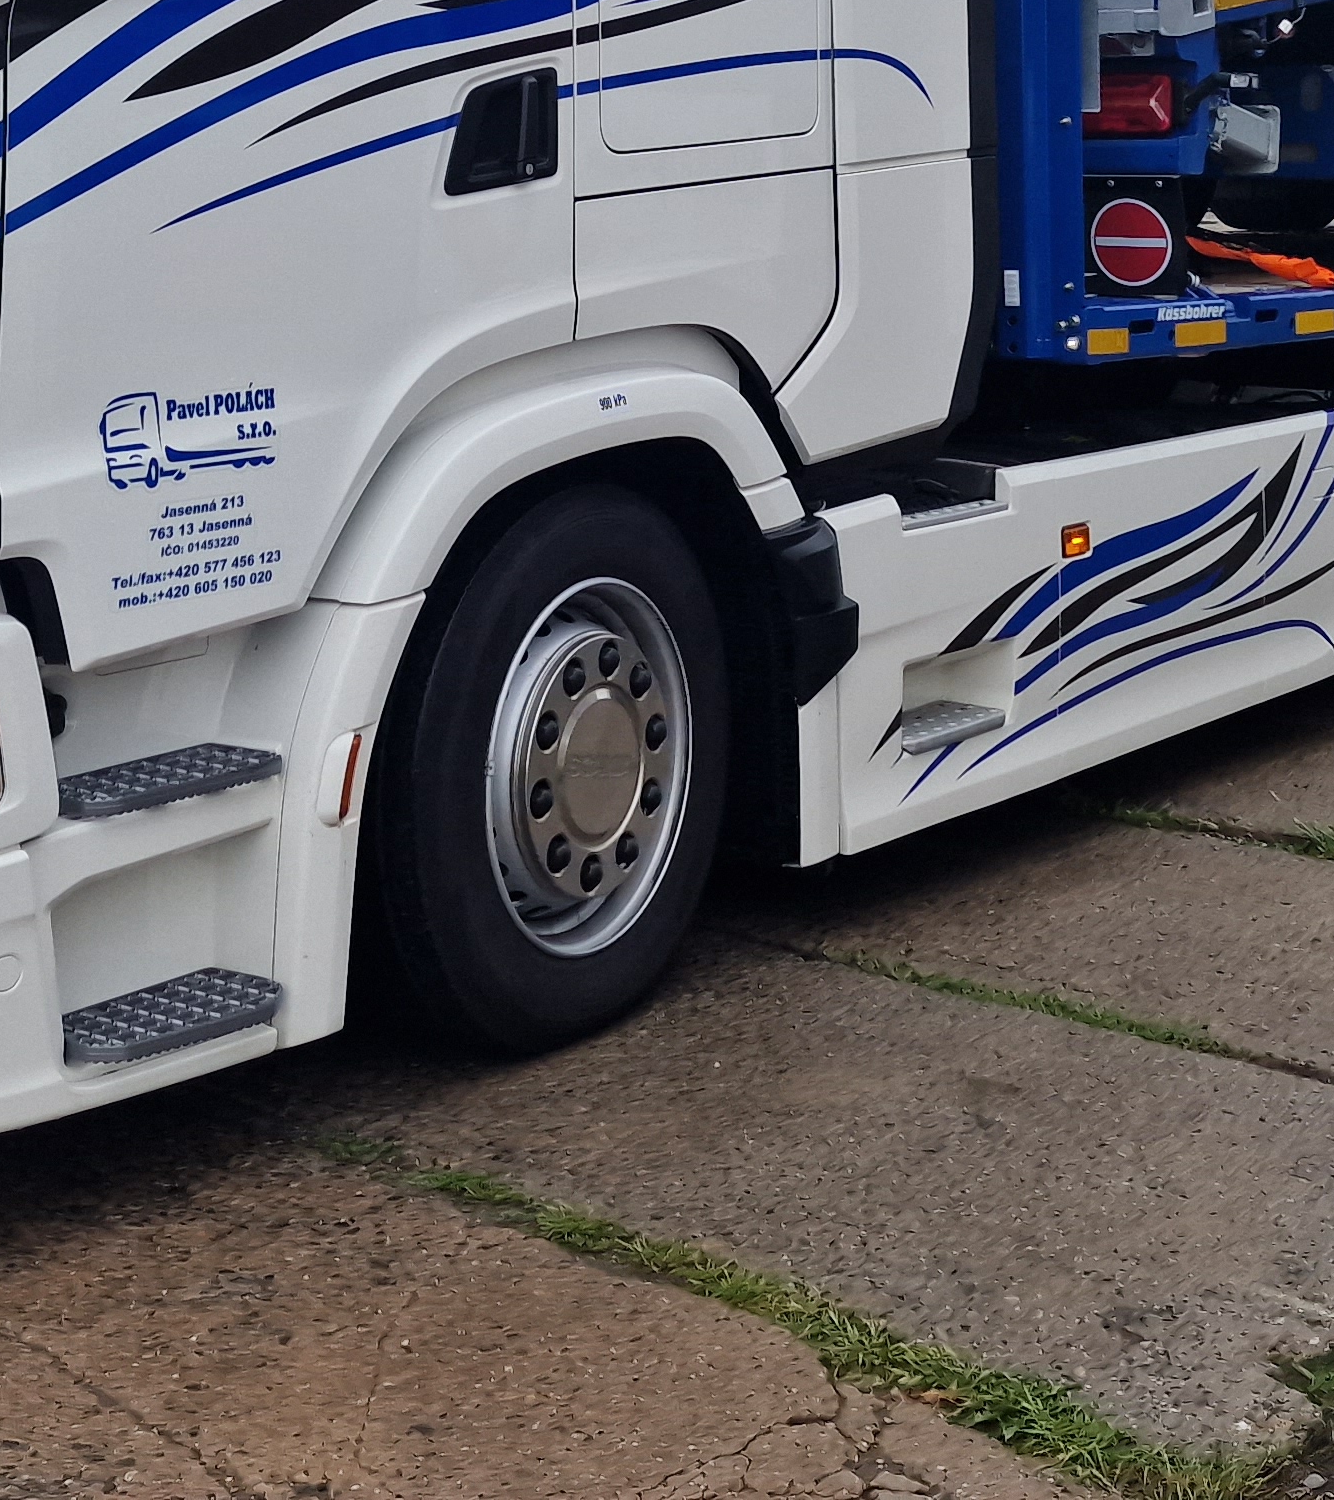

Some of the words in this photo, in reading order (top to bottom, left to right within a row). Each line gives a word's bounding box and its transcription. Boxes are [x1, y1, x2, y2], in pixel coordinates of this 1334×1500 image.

[1156, 303, 1226, 321] Kässbohrer
[166, 396, 210, 421] Pavel
[213, 382, 276, 416] POLÁCH
[237, 421, 277, 441] s.r.o.
[161, 499, 217, 519] Jasenná
[221, 495, 244, 509] 213
[149, 523, 174, 541] 763
[178, 522, 194, 537] 13
[198, 513, 253, 533] Jasenná
[160, 542, 184, 557] IČO:
[187, 535, 240, 553] 01453220
[203, 558, 228, 574] 577
[231, 553, 255, 568] 456
[259, 550, 282, 565] 123
[194, 579, 218, 595] 605
[223, 574, 246, 590] 150
[249, 569, 273, 585] 020
